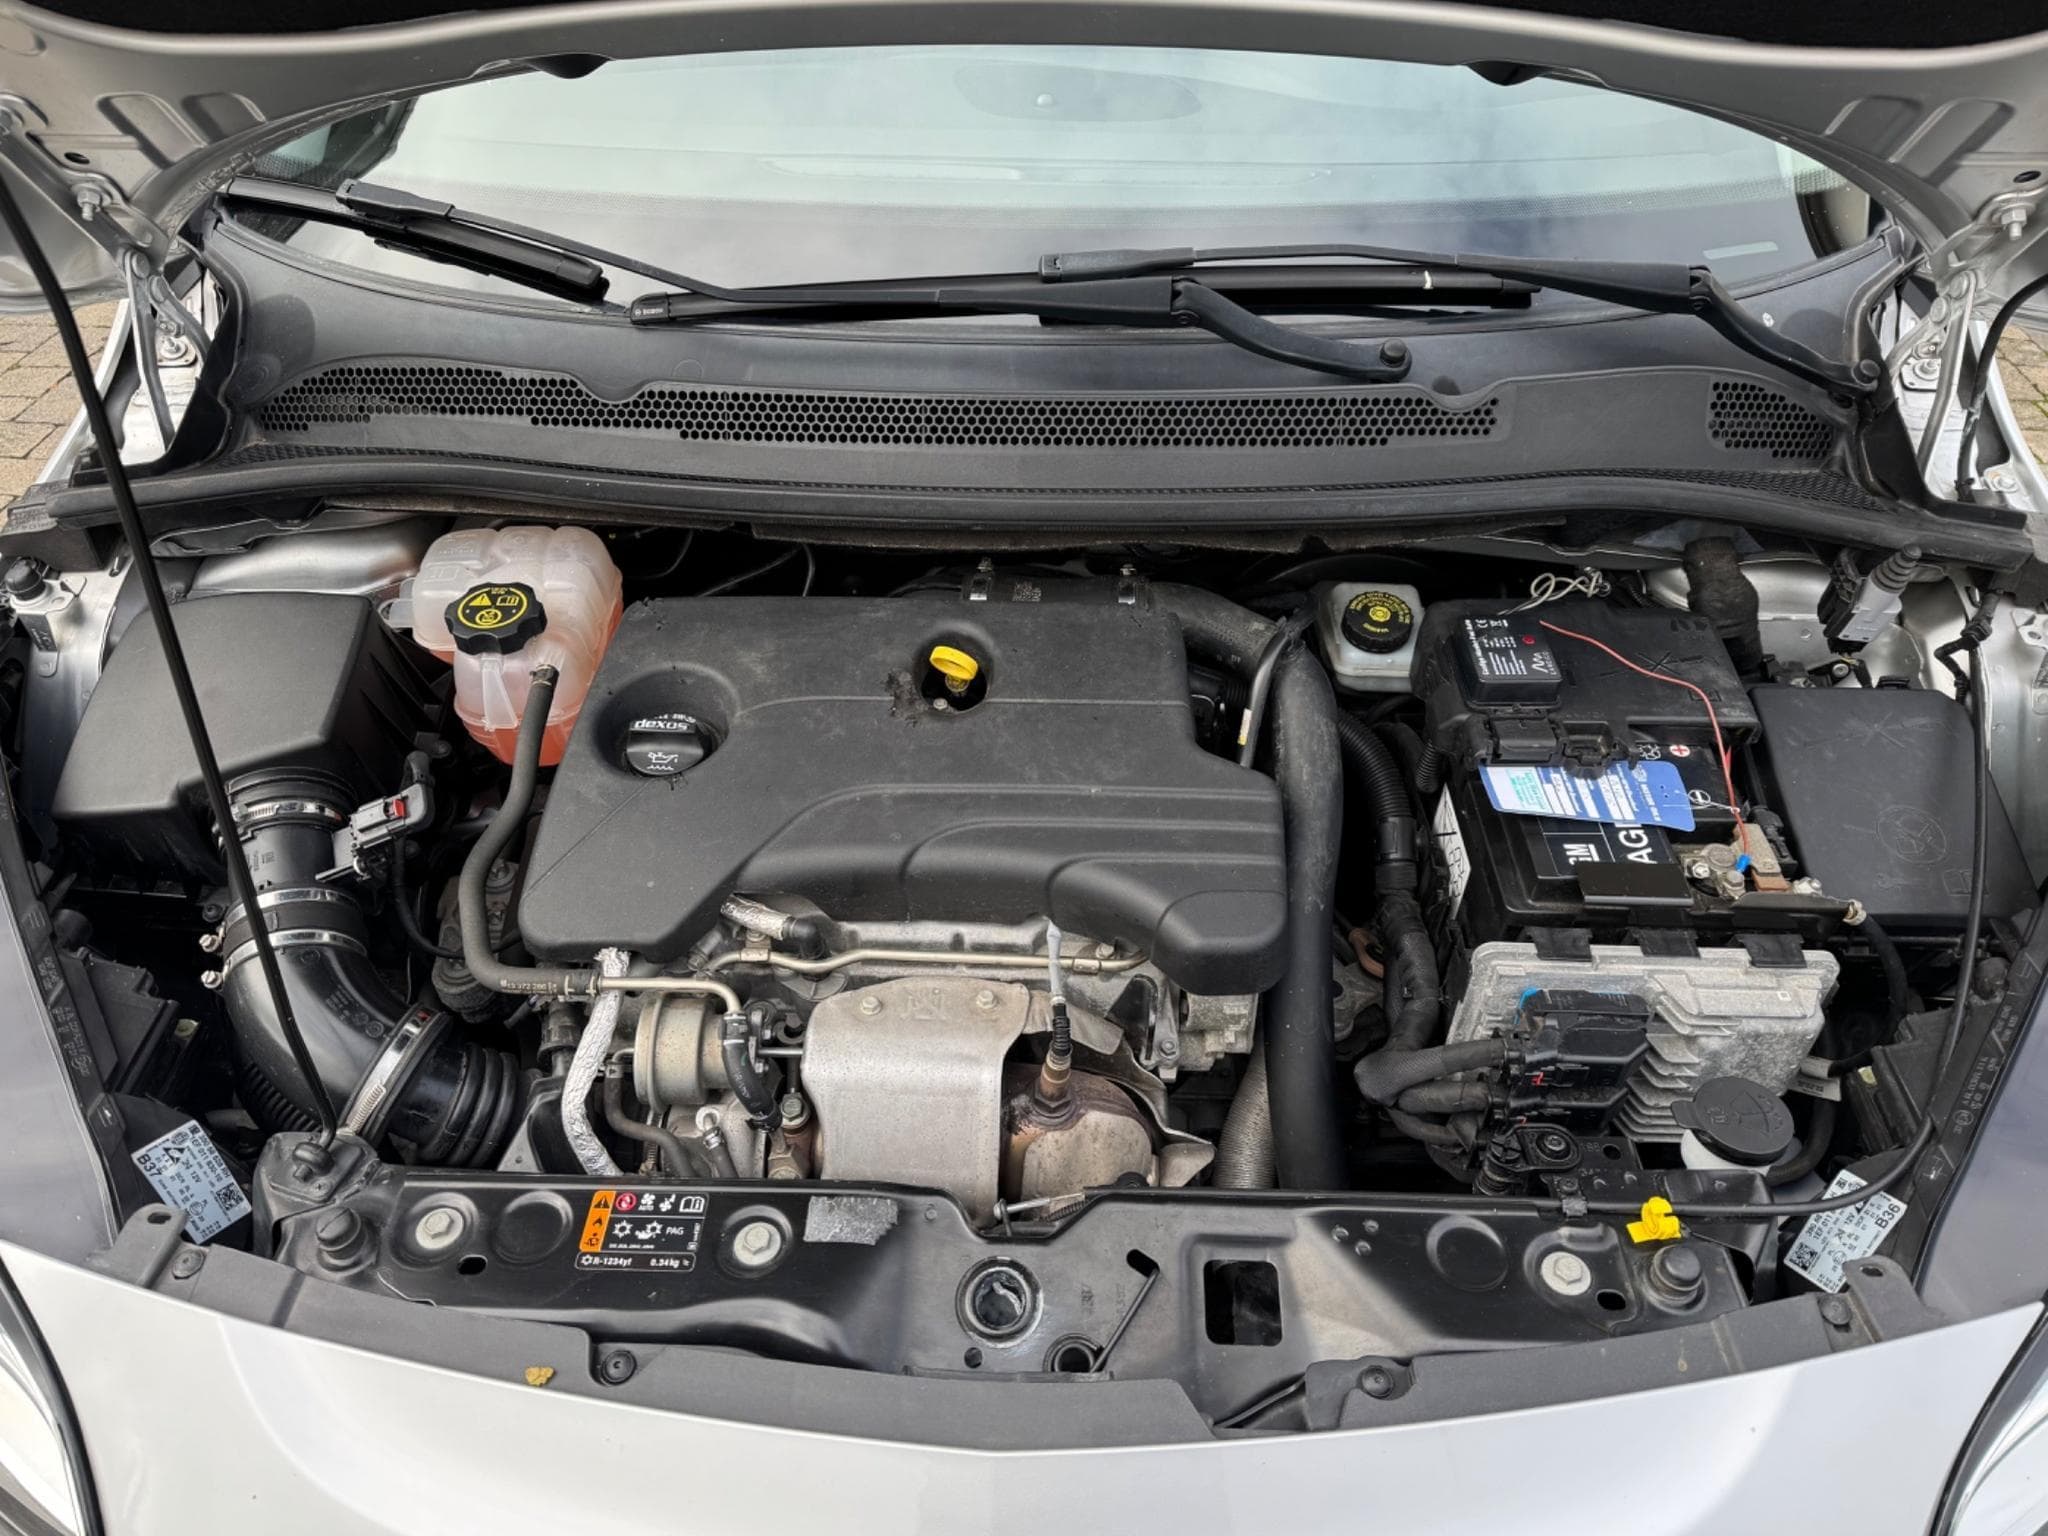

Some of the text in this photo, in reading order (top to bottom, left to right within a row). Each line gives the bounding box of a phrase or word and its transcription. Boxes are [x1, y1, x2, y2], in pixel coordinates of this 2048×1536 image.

[634, 718, 689, 731] dexos
[1614, 823, 1658, 864] AG
[137, 1153, 162, 1177] B37
[1875, 1203, 1901, 1229] B36
[666, 1226, 685, 1236] PAG
[593, 1256, 632, 1267] R-1234yf
